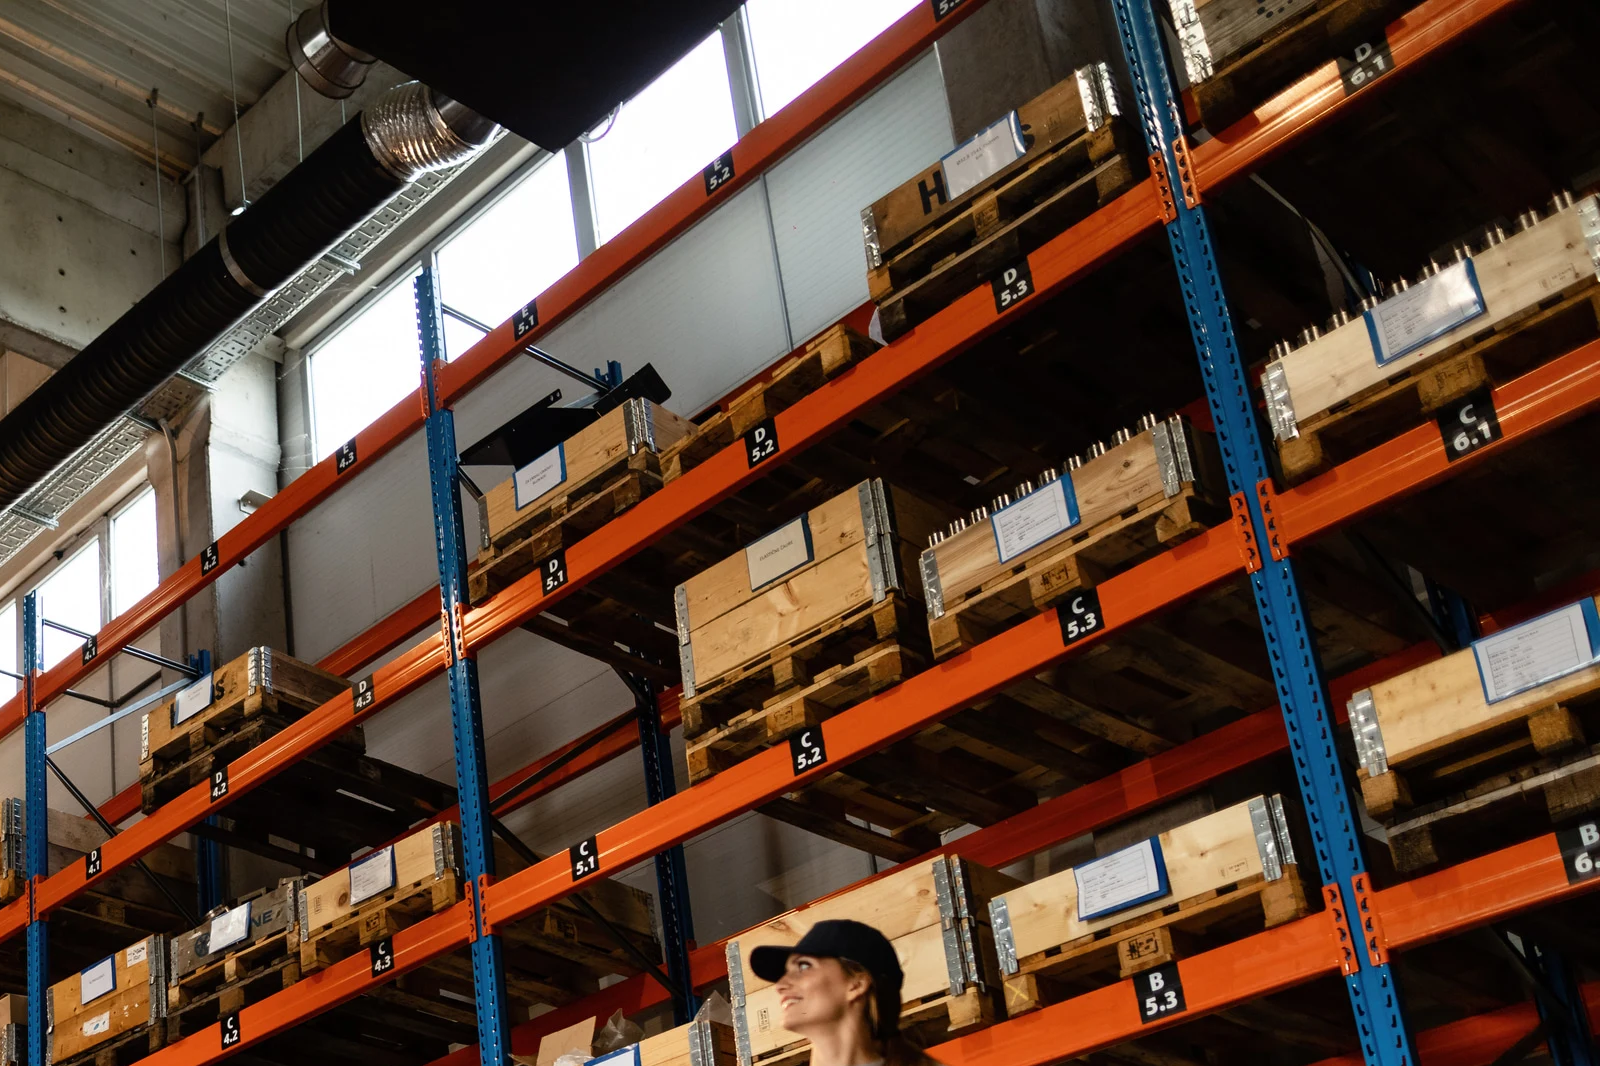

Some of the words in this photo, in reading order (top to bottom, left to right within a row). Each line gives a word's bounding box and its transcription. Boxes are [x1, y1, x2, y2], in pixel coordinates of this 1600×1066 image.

[1355, 43, 1371, 63] D
[1351, 55, 1385, 85] 6.1
[1004, 268, 1019, 286] D
[1001, 280, 1027, 306] 5.3
[522, 308, 529, 319] E
[518, 315, 534, 335] 5.1
[1459, 404, 1477, 424] C
[755, 428, 766, 444] D
[1454, 422, 1491, 451] 6.1
[343, 445, 349, 455] E
[753, 441, 774, 461] 5.2
[340, 452, 354, 468] 4.3
[207, 546, 212, 558] E
[204, 556, 216, 571] 4.2
[549, 560, 560, 574] D
[547, 571, 563, 590] 5.1
[1072, 597, 1085, 614] C
[1068, 612, 1096, 638] 5.3
[88, 638, 93, 648] E
[85, 646, 96, 660] 4.1
[359, 681, 366, 693] D
[356, 690, 371, 707] 4.3
[801, 732, 811, 747] C
[798, 746, 821, 769] 5.2
[216, 772, 224, 784] D
[213, 781, 226, 796] 4.2
[1580, 824, 1599, 846] B
[92, 851, 97, 861] D
[580, 842, 588, 855] C
[89, 861, 99, 873] 4.1
[577, 856, 594, 875] 5.1
[1575, 852, 1600, 873] 6.
[379, 942, 389, 956] C
[375, 956, 390, 971] 4.3
[1149, 973, 1164, 991] B
[1146, 989, 1177, 1015] 5.3
[227, 1017, 233, 1029] C
[224, 1026, 238, 1044] 4.2
